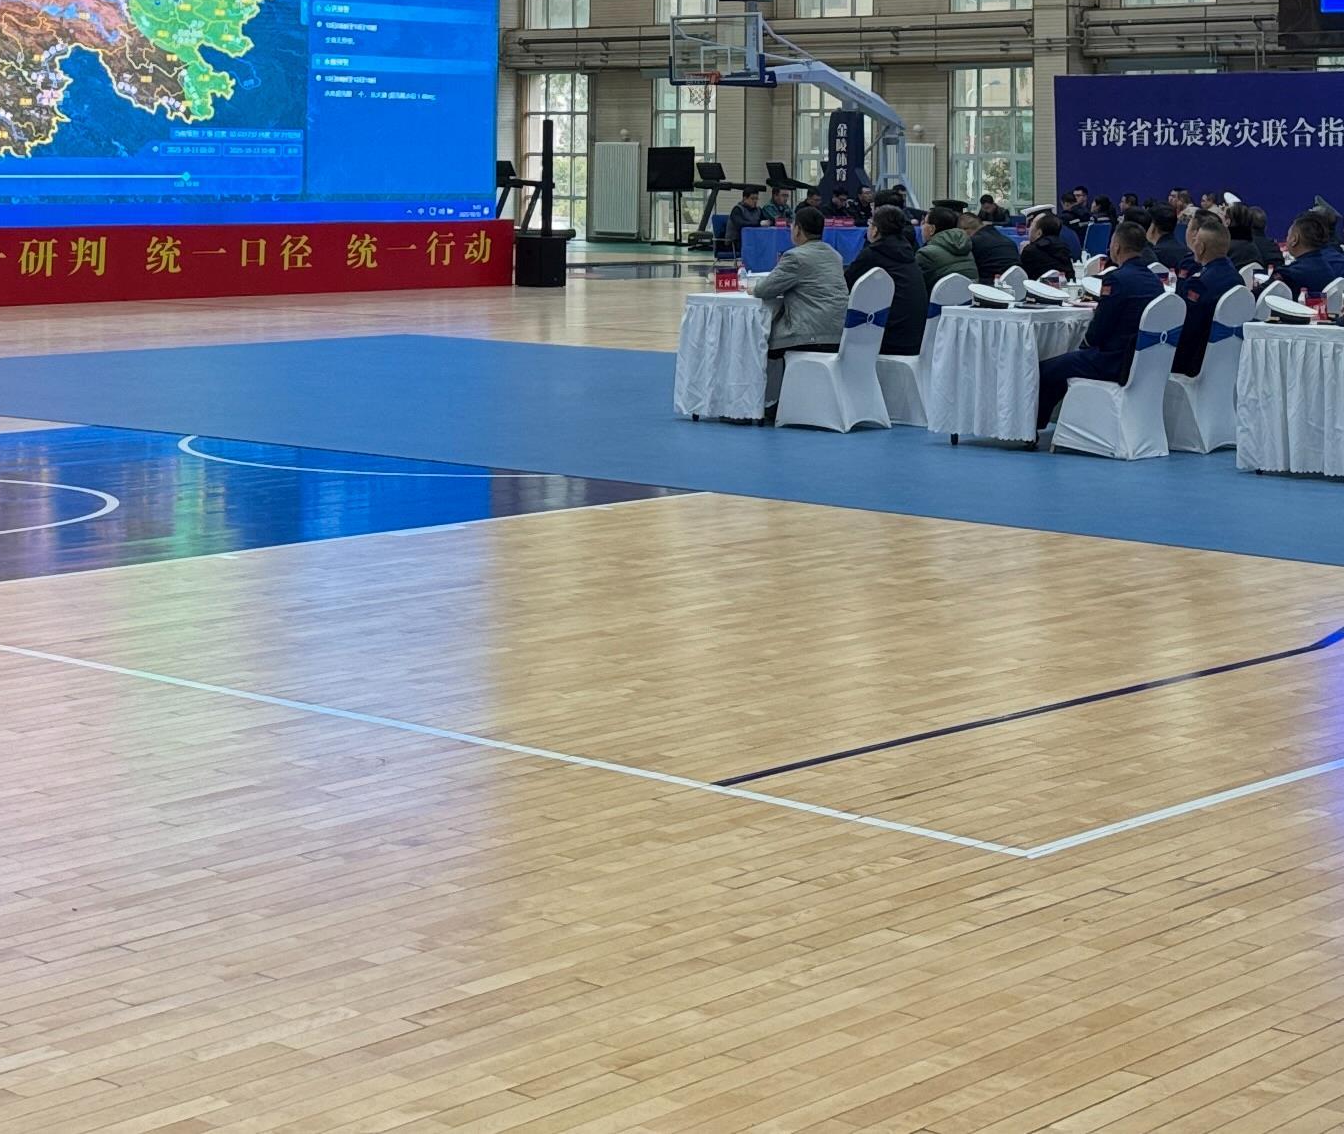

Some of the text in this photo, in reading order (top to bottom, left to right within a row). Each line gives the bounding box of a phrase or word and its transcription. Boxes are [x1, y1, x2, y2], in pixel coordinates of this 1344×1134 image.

[145, 233, 314, 275] 统一口径
[346, 229, 493, 270] 统一行动
